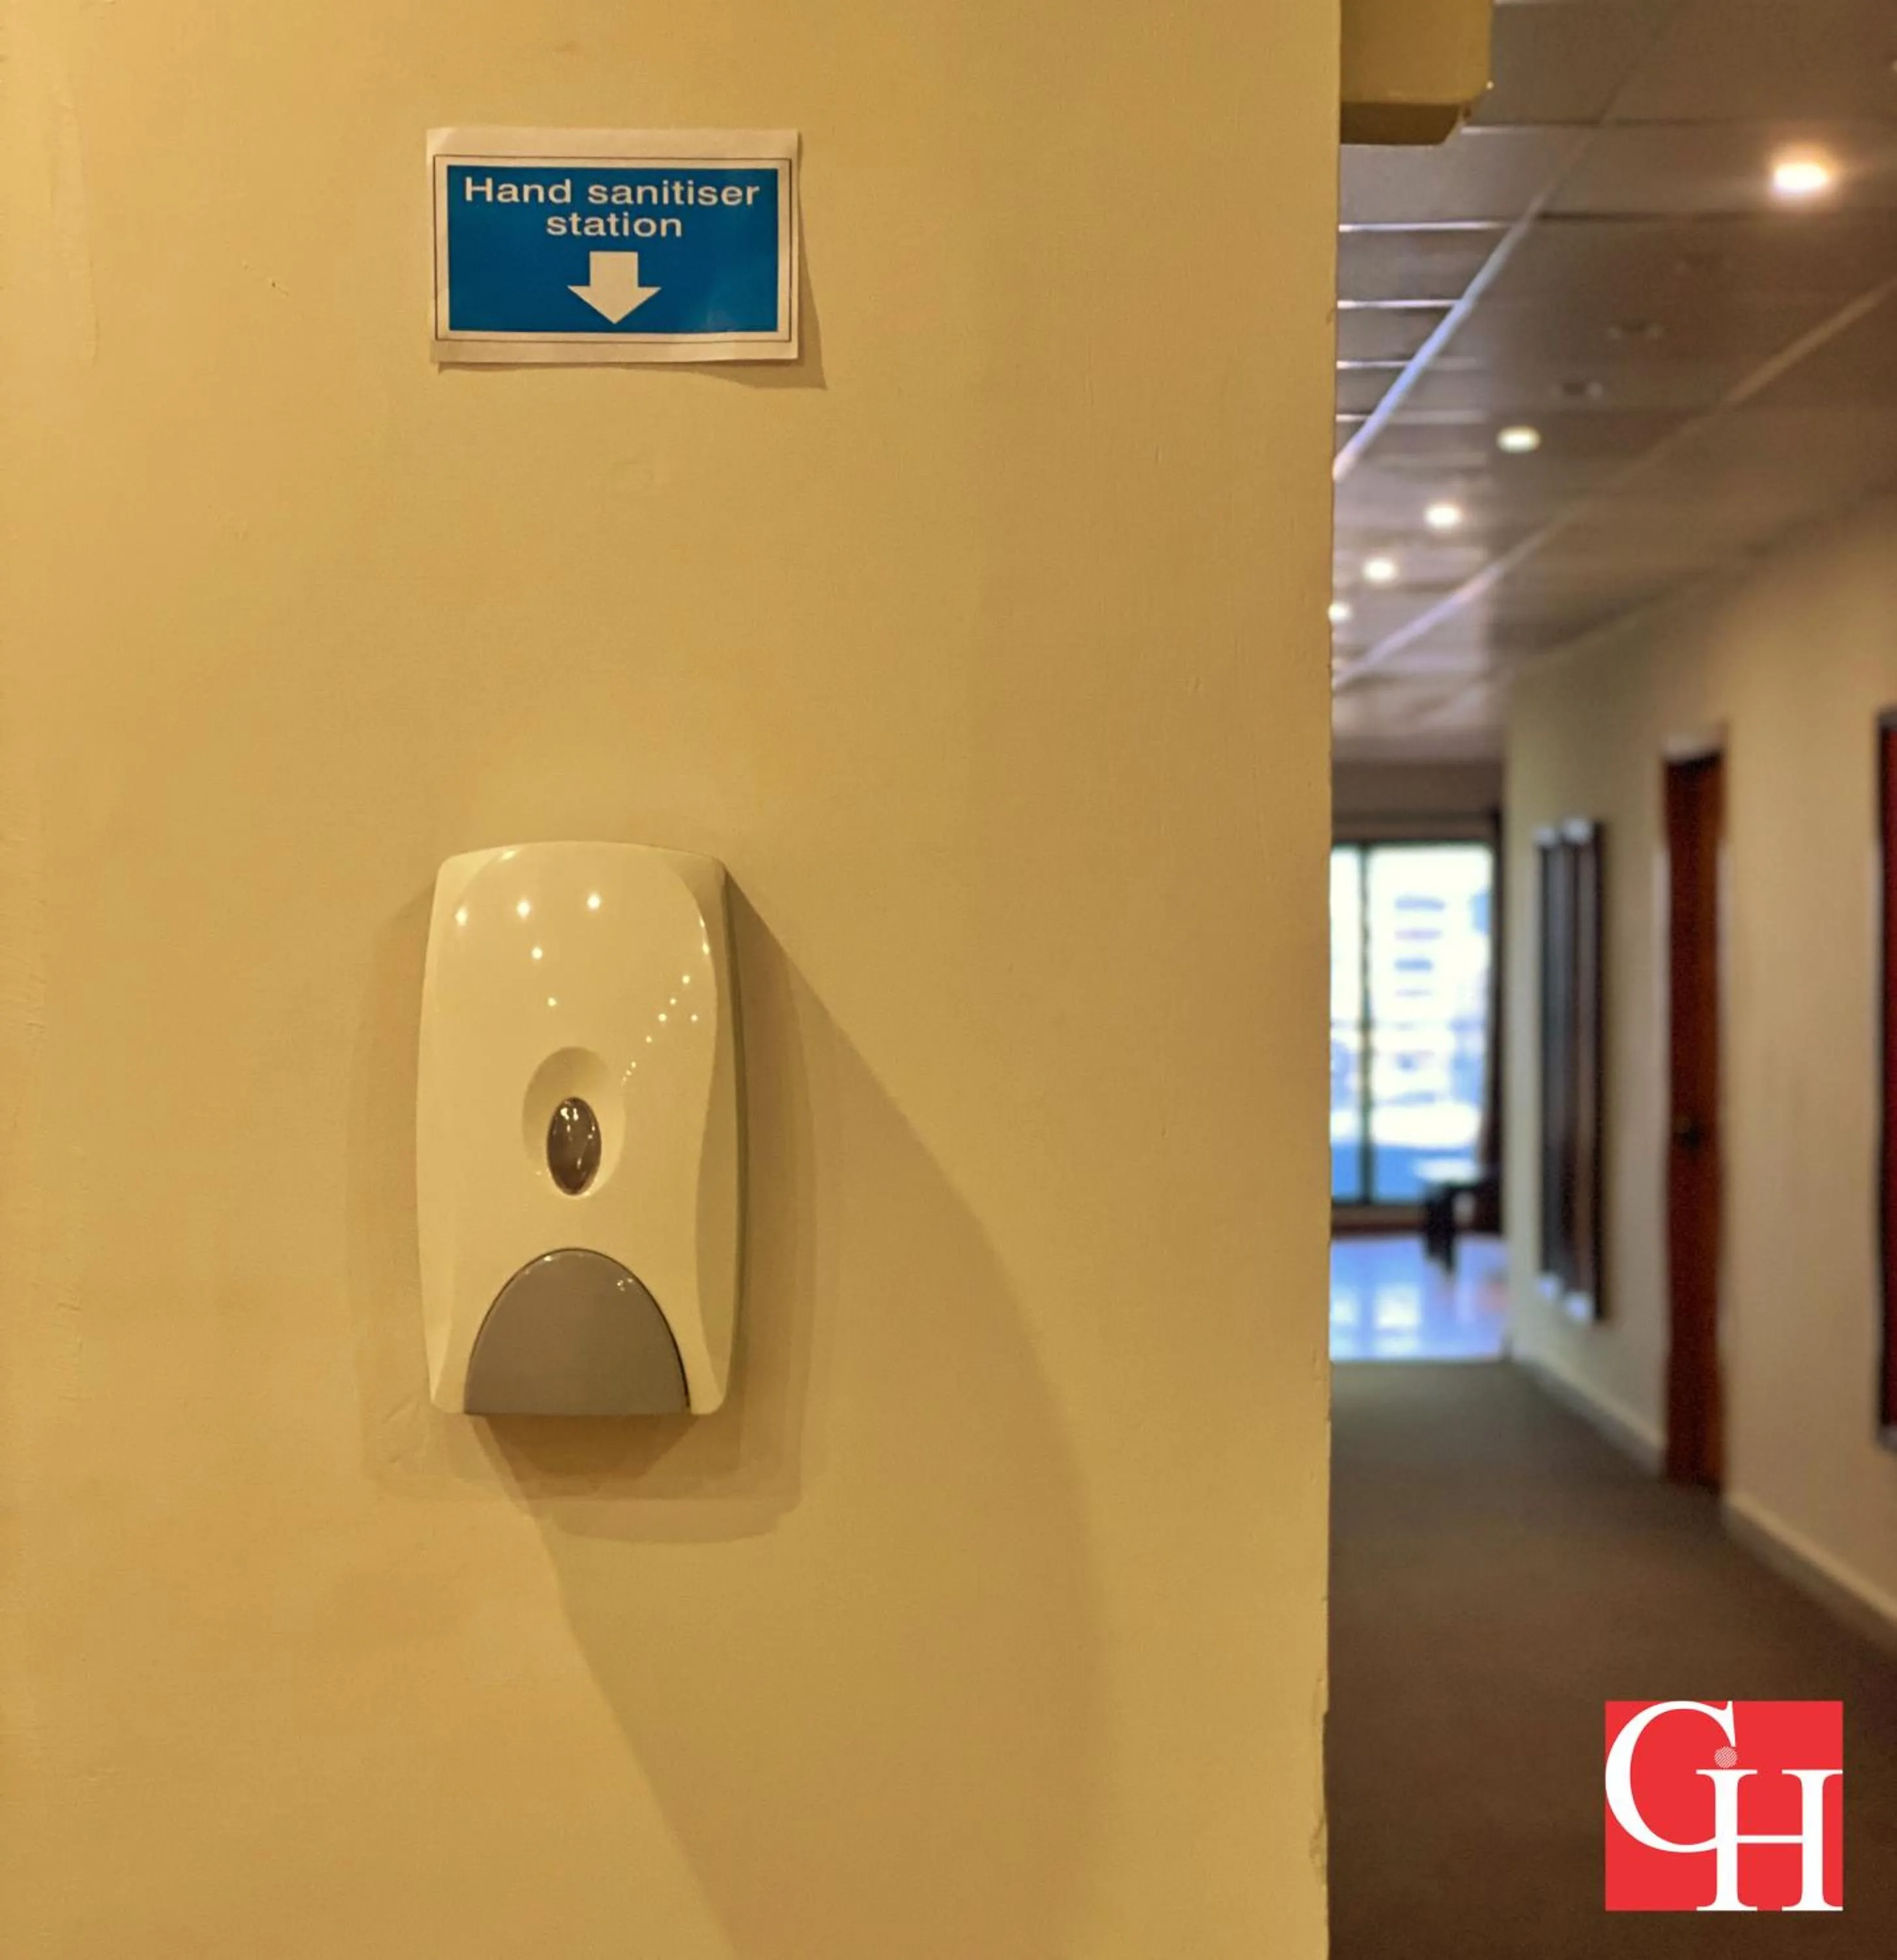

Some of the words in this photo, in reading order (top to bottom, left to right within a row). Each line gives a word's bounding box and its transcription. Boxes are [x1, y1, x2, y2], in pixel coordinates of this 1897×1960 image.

[464, 176, 572, 204] Hand
[587, 179, 760, 206] sanitiser
[545, 211, 683, 237] station
